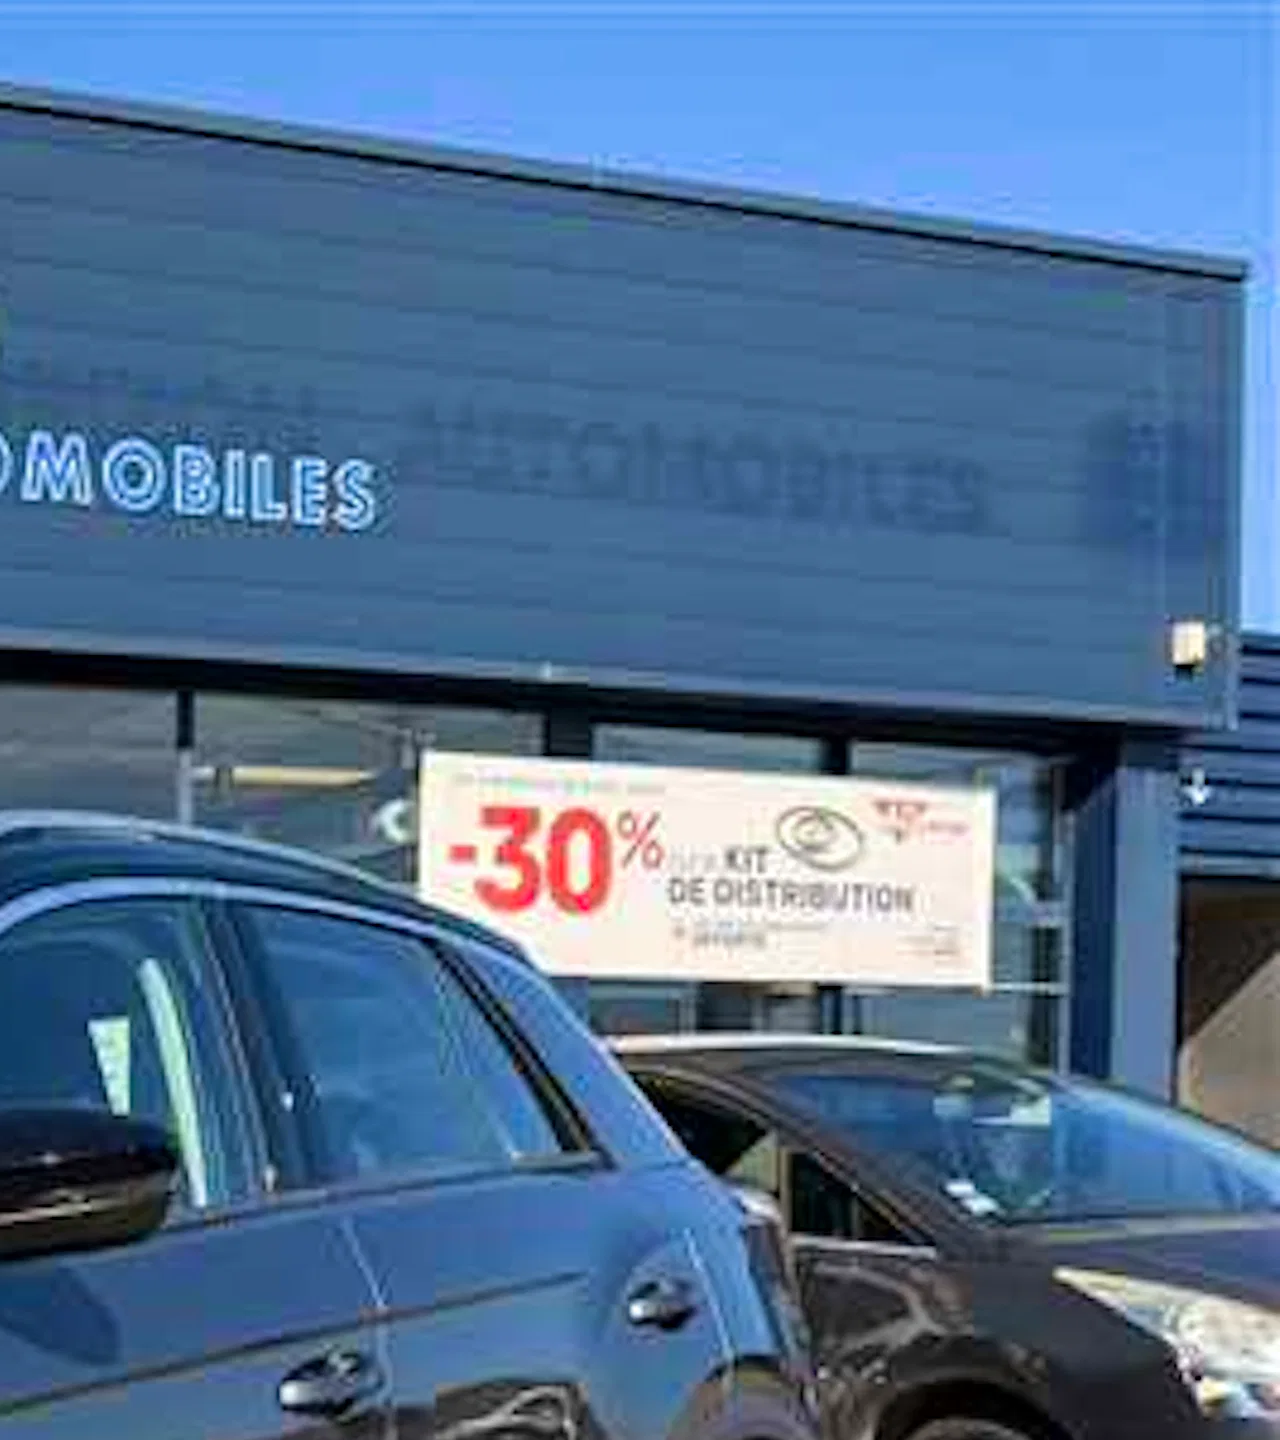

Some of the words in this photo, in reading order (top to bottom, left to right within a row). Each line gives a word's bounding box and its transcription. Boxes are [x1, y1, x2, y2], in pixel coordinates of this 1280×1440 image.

[447, 805, 665, 914] -30%
[723, 845, 771, 874] KIT
[668, 877, 707, 906] DE
[713, 878, 916, 913] DISTRIBUTION
